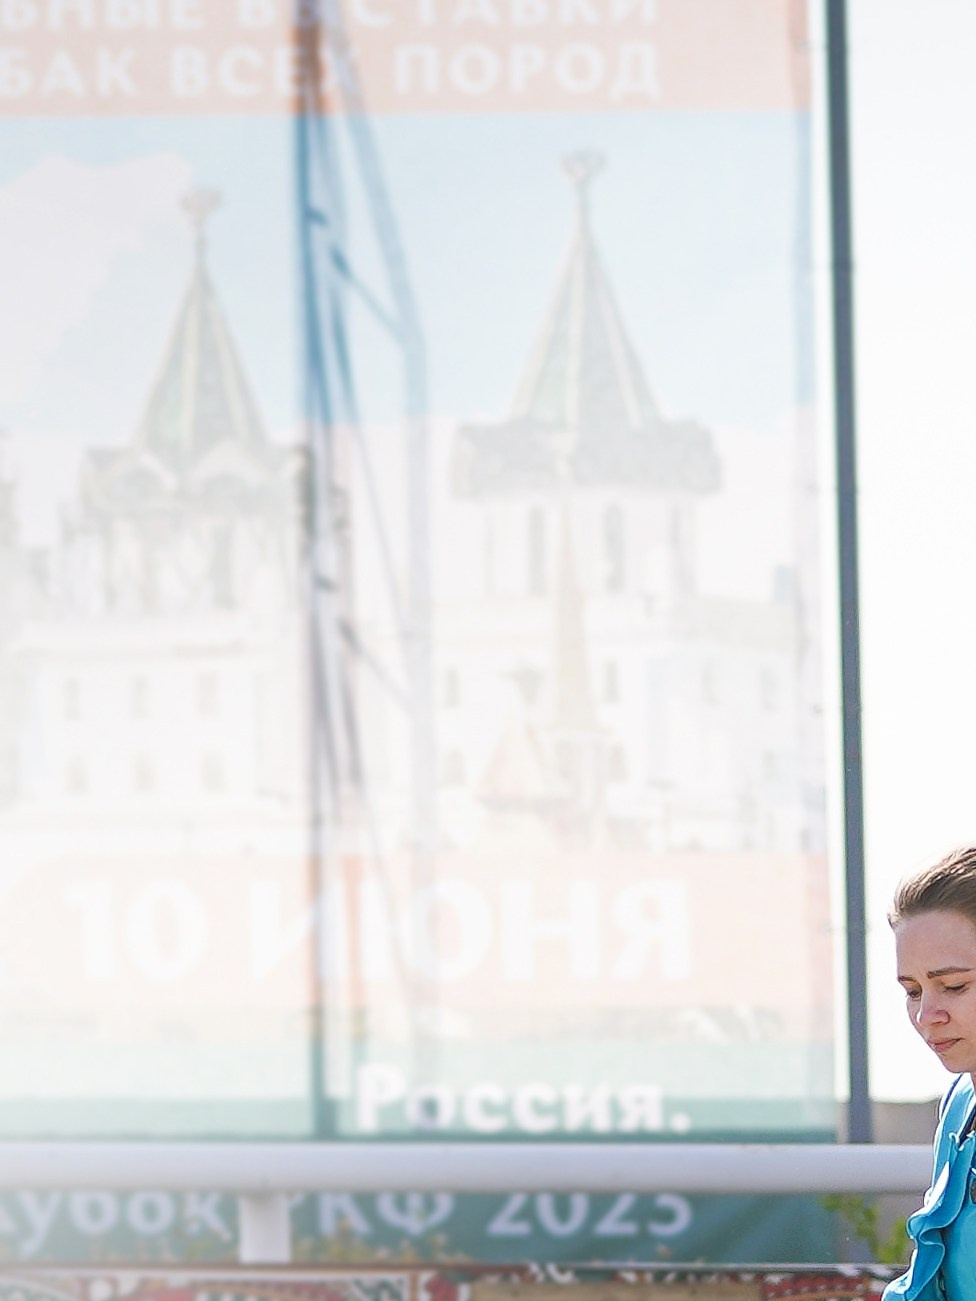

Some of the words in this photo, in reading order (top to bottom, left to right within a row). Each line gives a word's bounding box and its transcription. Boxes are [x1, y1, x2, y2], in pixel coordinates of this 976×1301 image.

[238, 0, 656, 30] ВСТАВКИ
[0, 45, 136, 97] БАК
[394, 41, 661, 102] ПОРОД
[62, 878, 209, 982] 10
[248, 878, 693, 982] ИЮНЯ
[356, 1062, 692, 1134] Россия.
[288, 1190, 454, 1237] КФ
[486, 1190, 693, 1237] 2023
